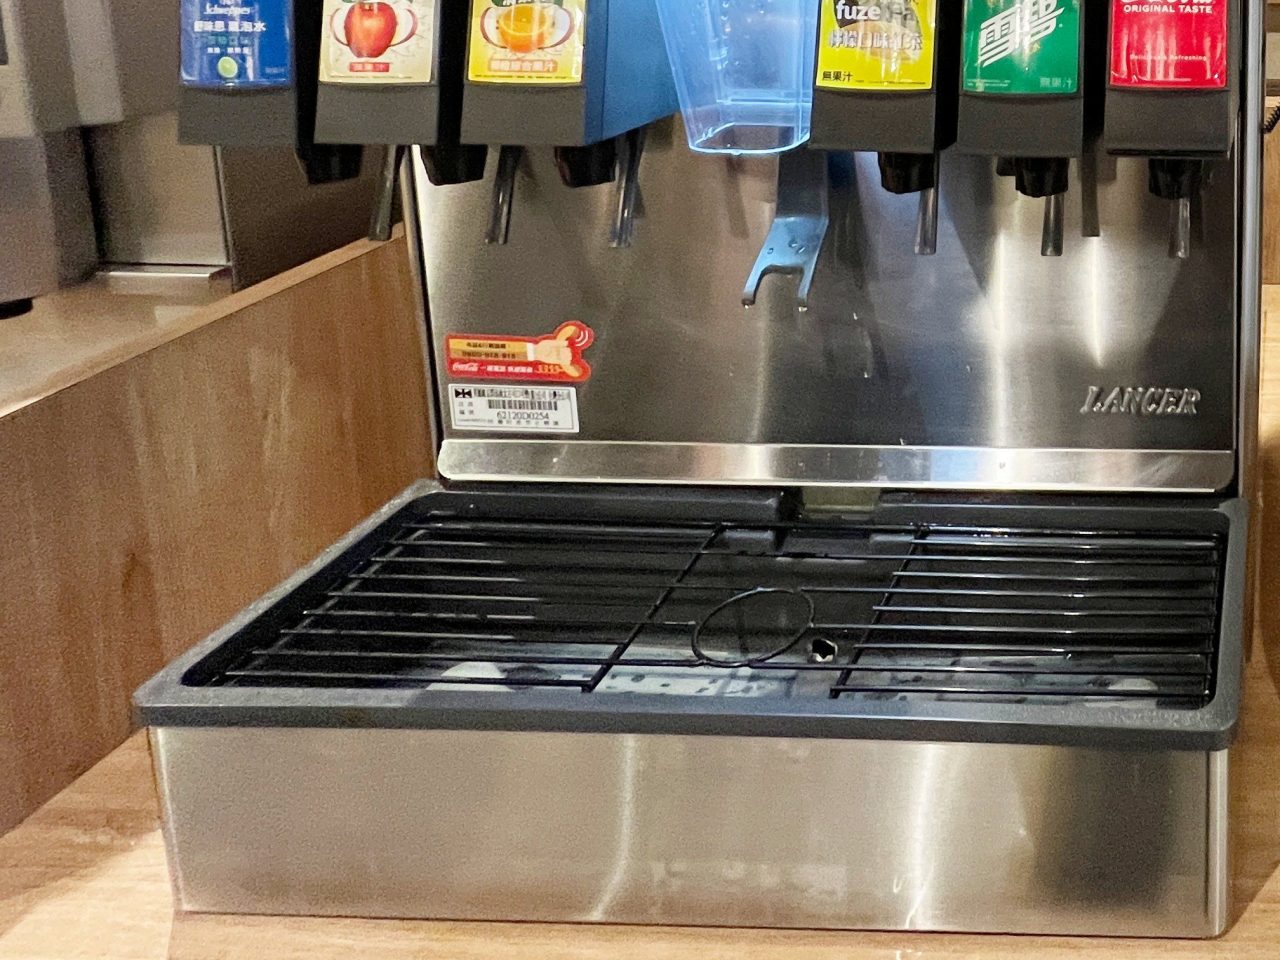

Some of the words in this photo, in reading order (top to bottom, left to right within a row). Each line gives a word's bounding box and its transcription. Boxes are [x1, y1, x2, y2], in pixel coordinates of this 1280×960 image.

[836, 0, 880, 20] fuze
[1123, 5, 1175, 13] ORIGINAL
[1178, 5, 1212, 14] TASTE
[822, 71, 853, 82] 無果汁
[1079, 386, 1201, 414] LANCER
